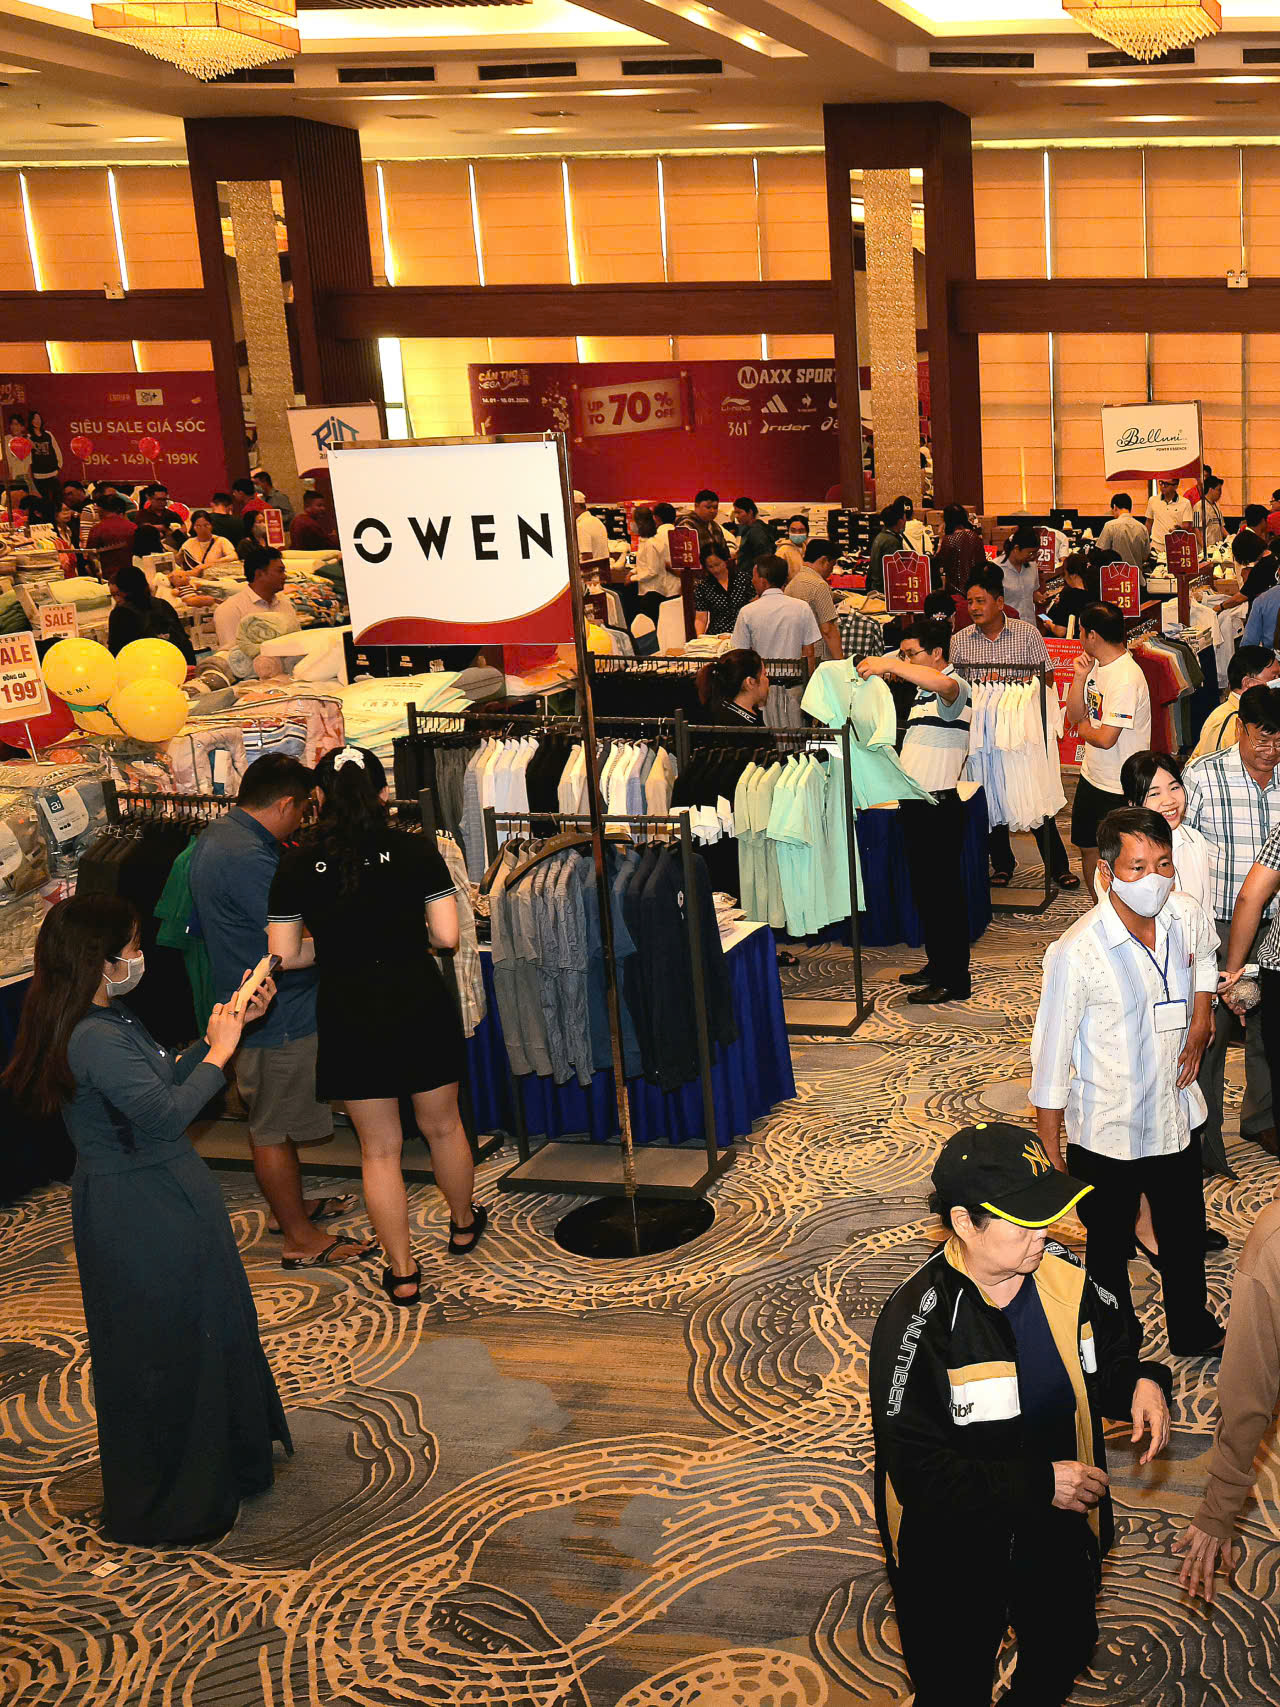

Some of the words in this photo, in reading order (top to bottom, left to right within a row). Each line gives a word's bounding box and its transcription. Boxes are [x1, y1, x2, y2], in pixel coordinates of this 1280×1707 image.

[587, 400, 604, 412] UP
[608, 391, 651, 425] 70
[70, 418, 103, 433] SIÊU
[106, 421, 143, 433] SALE
[146, 418, 173, 433] GIÁ
[175, 416, 206, 433] SỐC
[588, 414, 605, 425] TO
[166, 453, 200, 465] 199K
[353, 513, 554, 564] OWEN
[45, 612, 74, 628] SALE
[0, 644, 33, 666] ALE
[886, 1313, 927, 1417] NUMBER
